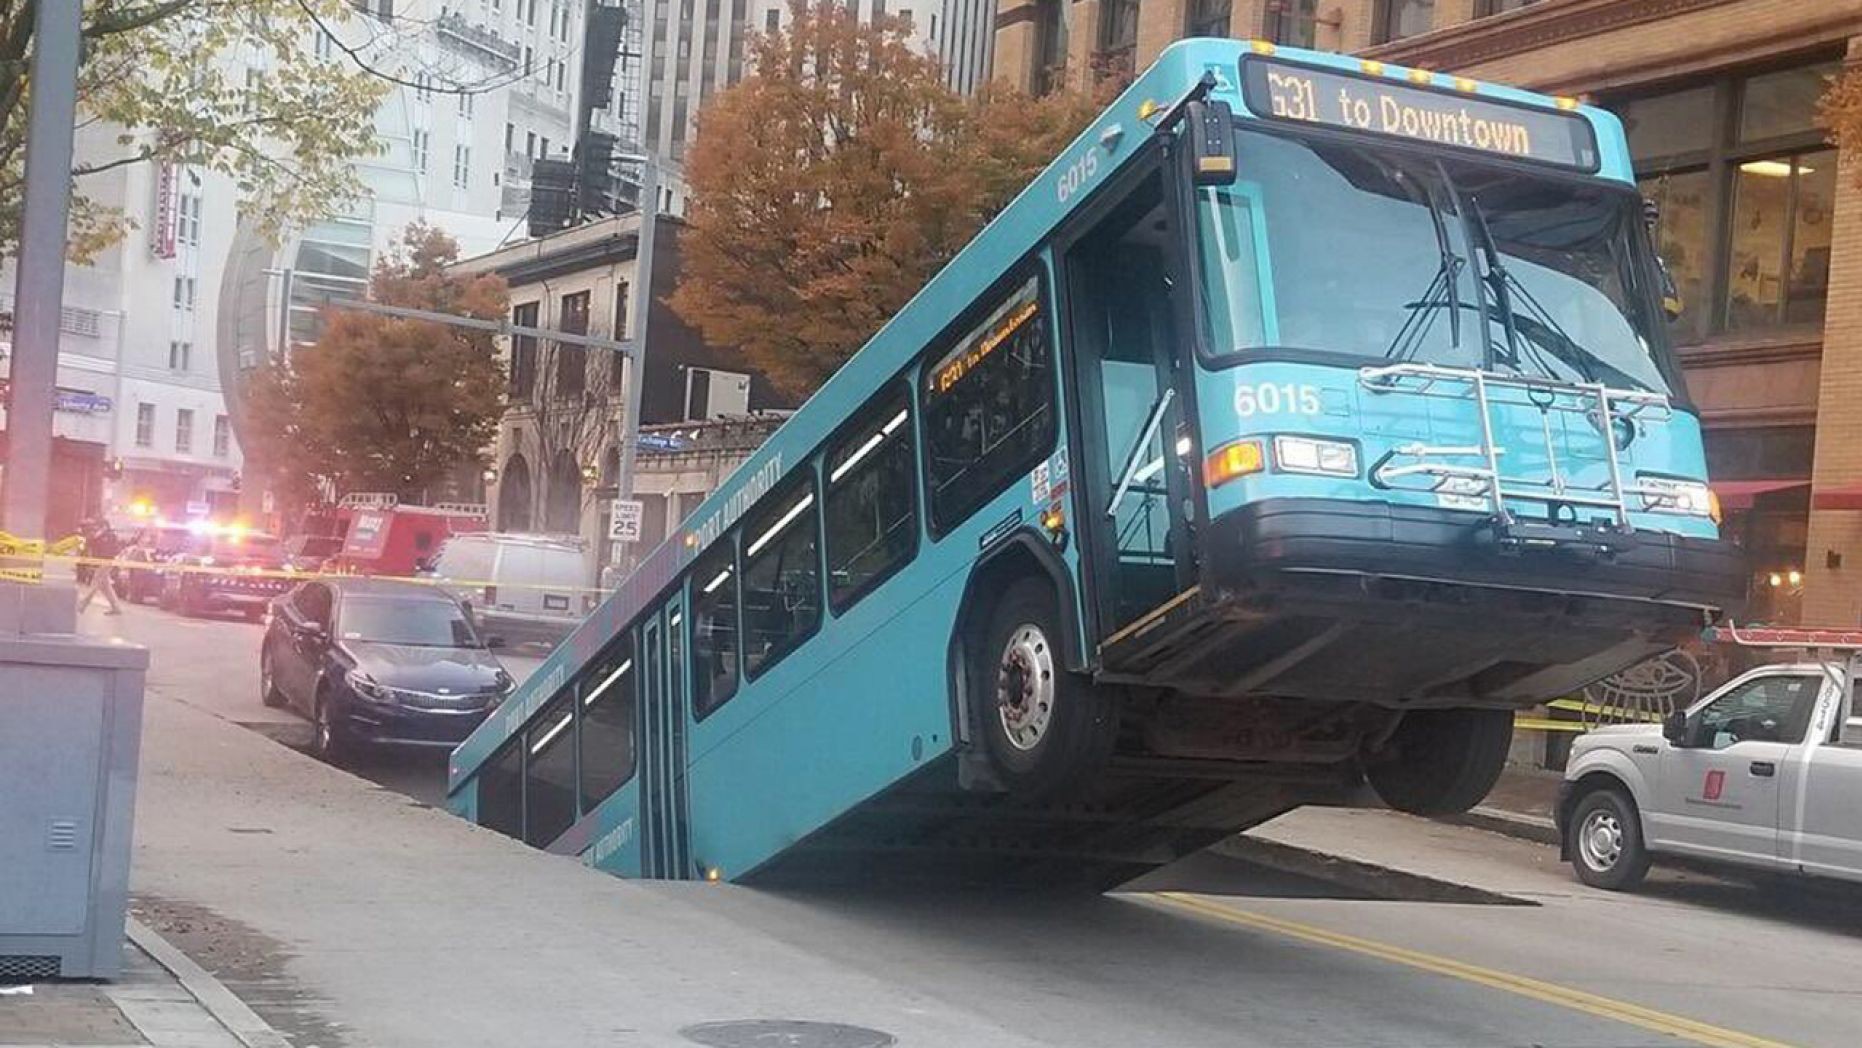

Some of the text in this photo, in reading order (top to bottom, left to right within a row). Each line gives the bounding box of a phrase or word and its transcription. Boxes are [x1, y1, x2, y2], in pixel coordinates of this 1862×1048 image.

[1267, 71, 1529, 155] G31 to Downtown
[1057, 146, 1097, 202] 6015
[1233, 382, 1320, 417] 6015
[722, 451, 783, 532] AUTHORITY
[613, 520, 638, 536] 25
